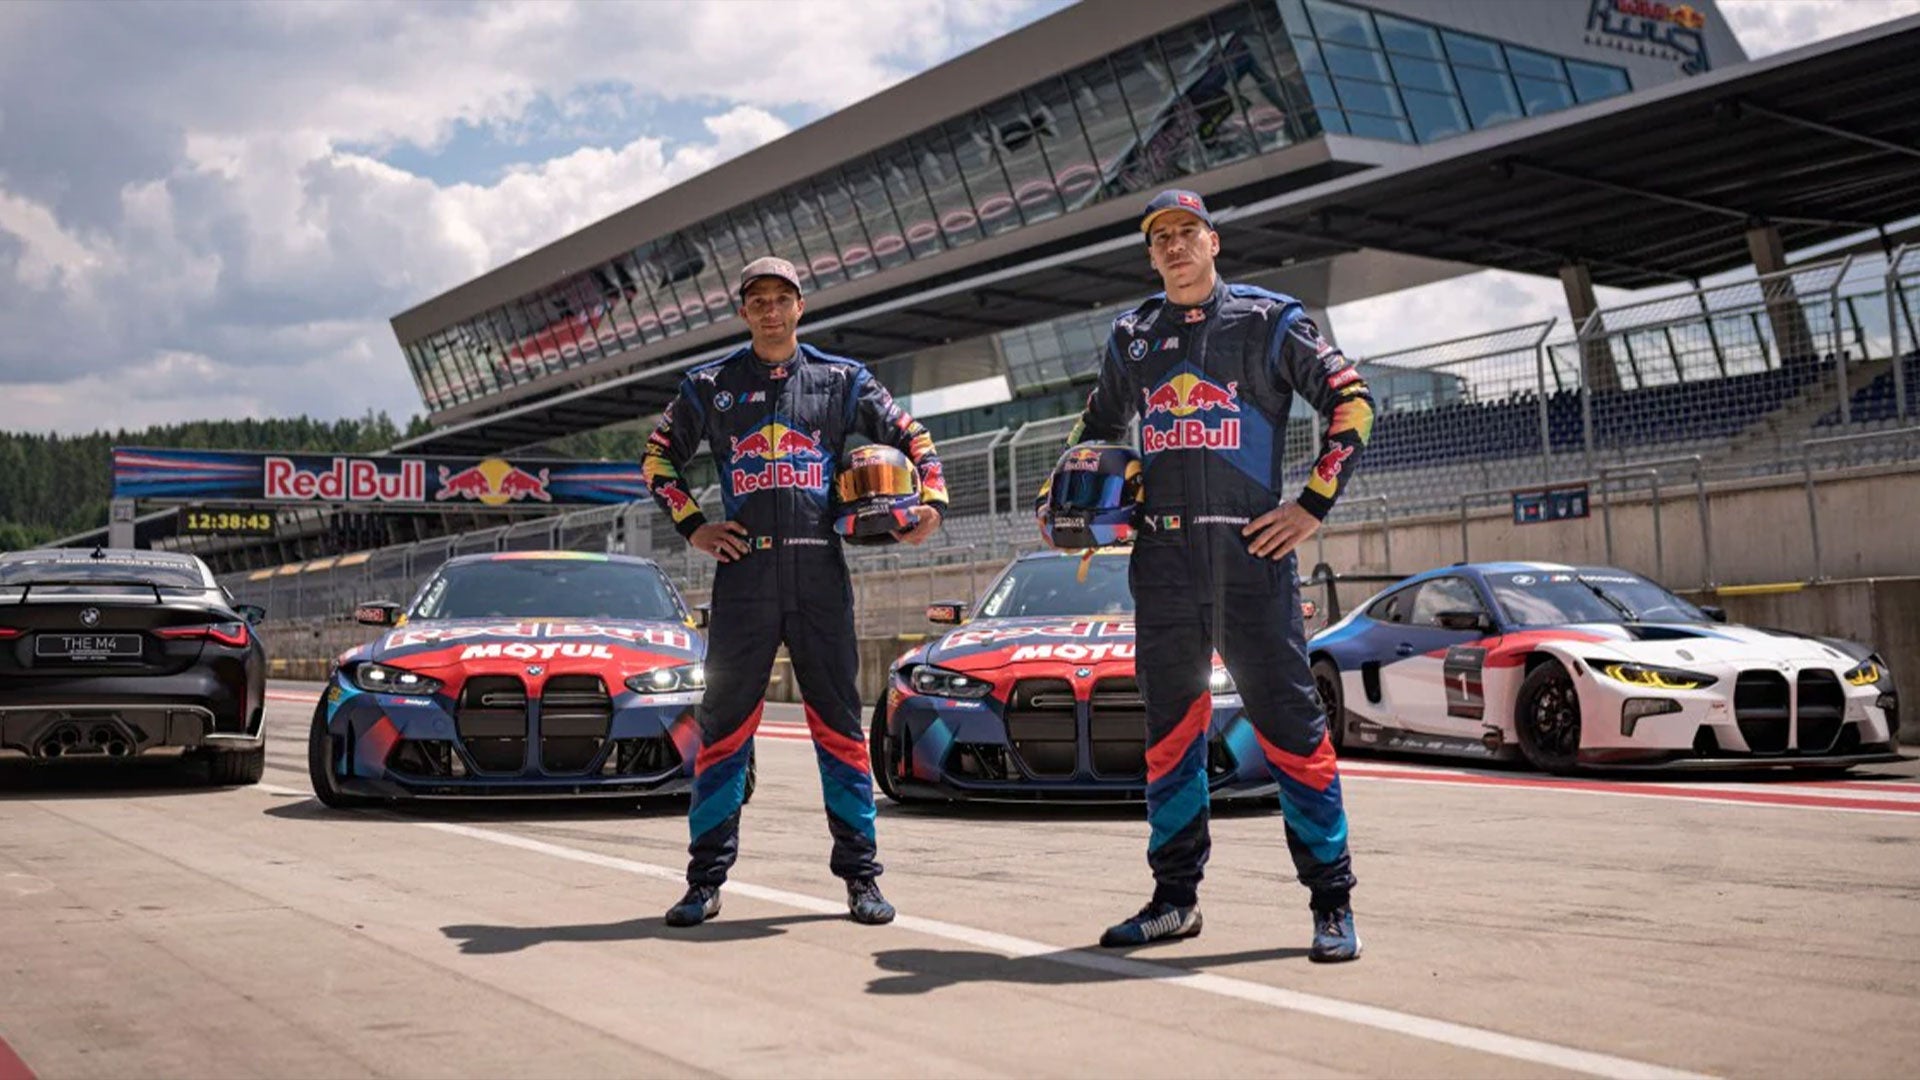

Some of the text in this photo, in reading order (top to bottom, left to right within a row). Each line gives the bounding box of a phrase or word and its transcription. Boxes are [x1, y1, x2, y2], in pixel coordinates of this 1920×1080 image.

[1142, 418, 1240, 455] Red Bull
[265, 457, 426, 502] Red Bull
[732, 462, 774, 497] Red
[775, 462, 823, 490] Bull
[188, 514, 270, 530] 12:38:43
[62, 637, 116, 650] THE M4
[384, 622, 692, 651] Red Bull
[459, 642, 614, 660] MOTUL
[1010, 643, 1136, 661] MOTU
[1458, 671, 1469, 700] 1
